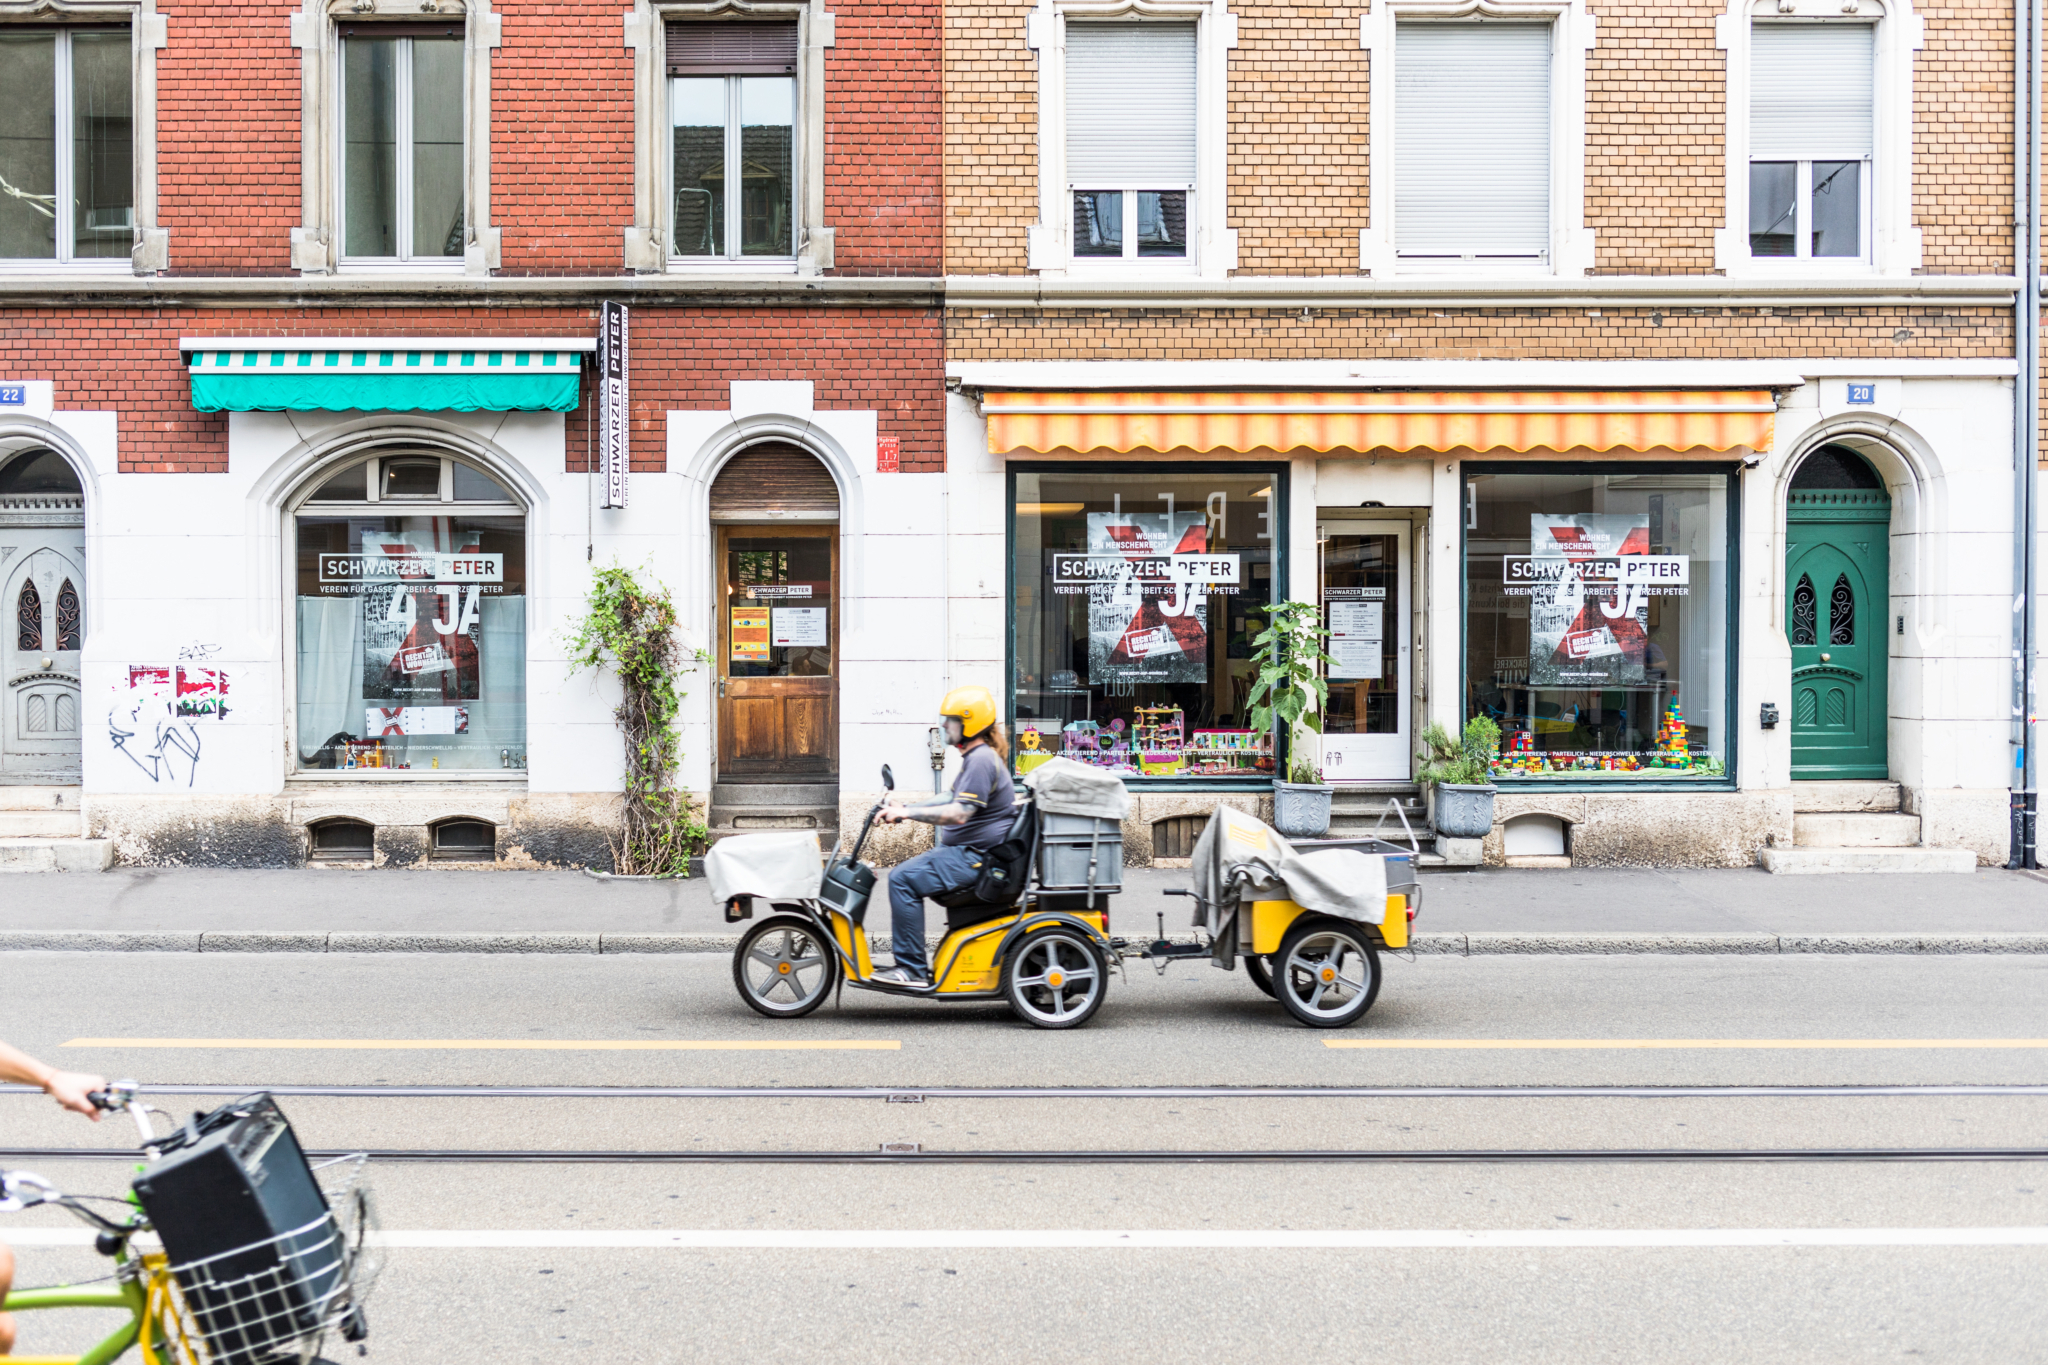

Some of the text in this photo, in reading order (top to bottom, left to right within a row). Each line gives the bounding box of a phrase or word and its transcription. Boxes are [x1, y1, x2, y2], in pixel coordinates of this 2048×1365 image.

[2, 388, 19, 401] 22
[1853, 387, 1869, 400] 20
[610, 311, 620, 499] SCHWARZER PETER
[1135, 532, 1168, 540] WOHNEN
[1579, 533, 1611, 542] WOHNEN
[1106, 541, 1168, 549] MENSCHENRECHT
[1535, 542, 1611, 550] EIN MENSCHENRECHT
[327, 560, 431, 576] SCHWARZER
[442, 561, 495, 575] PETER
[1061, 560, 1232, 576] SCHWARZER PETER
[1511, 561, 1681, 578] SCHWARZER PETER
[319, 585, 349, 593] VEREIN
[350, 584, 367, 593] FÜR
[479, 585, 504, 593] PETER
[1053, 586, 1083, 594] VEREIN
[1084, 585, 1101, 594] FÜR
[1214, 586, 1240, 594] PETER
[1503, 587, 1533, 595] VEREIN
[1535, 586, 1551, 595] FÜR
[1663, 587, 1689, 595] PETER
[404, 652, 426, 662] RECHT
